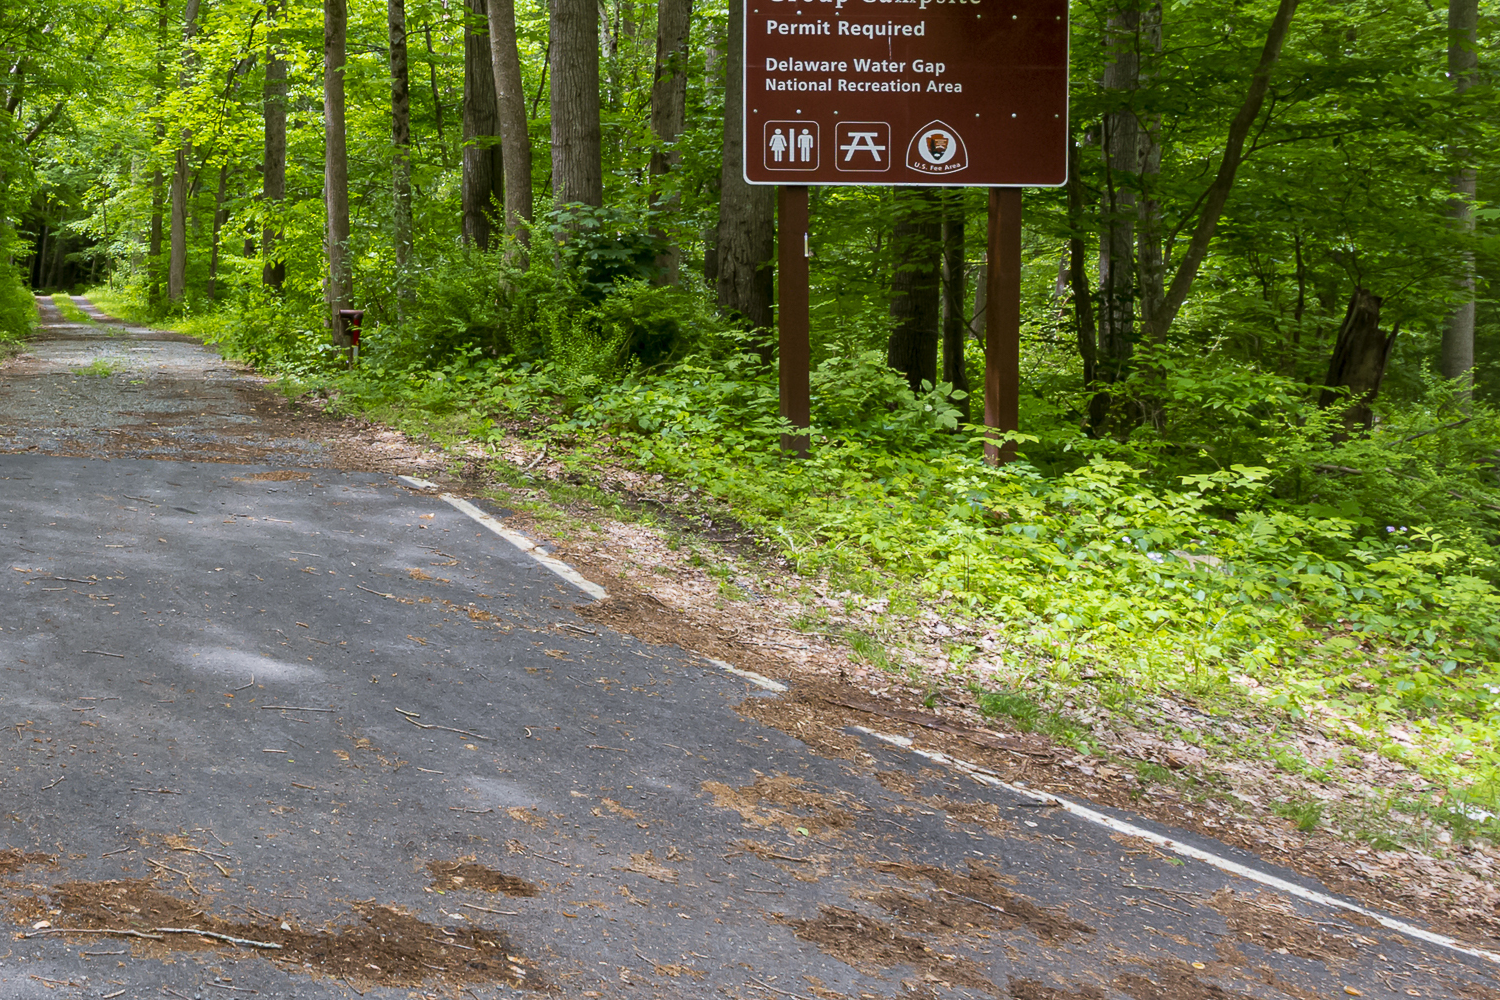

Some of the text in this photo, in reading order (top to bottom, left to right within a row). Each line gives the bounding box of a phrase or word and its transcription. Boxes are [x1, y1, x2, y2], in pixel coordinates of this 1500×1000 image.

[766, 19, 925, 39] Permit Required
[765, 57, 946, 77] Delaware Water Gap
[765, 78, 963, 93] National Recreation Area
[914, 161, 928, 170] U.S.
[944, 162, 961, 171] Area
